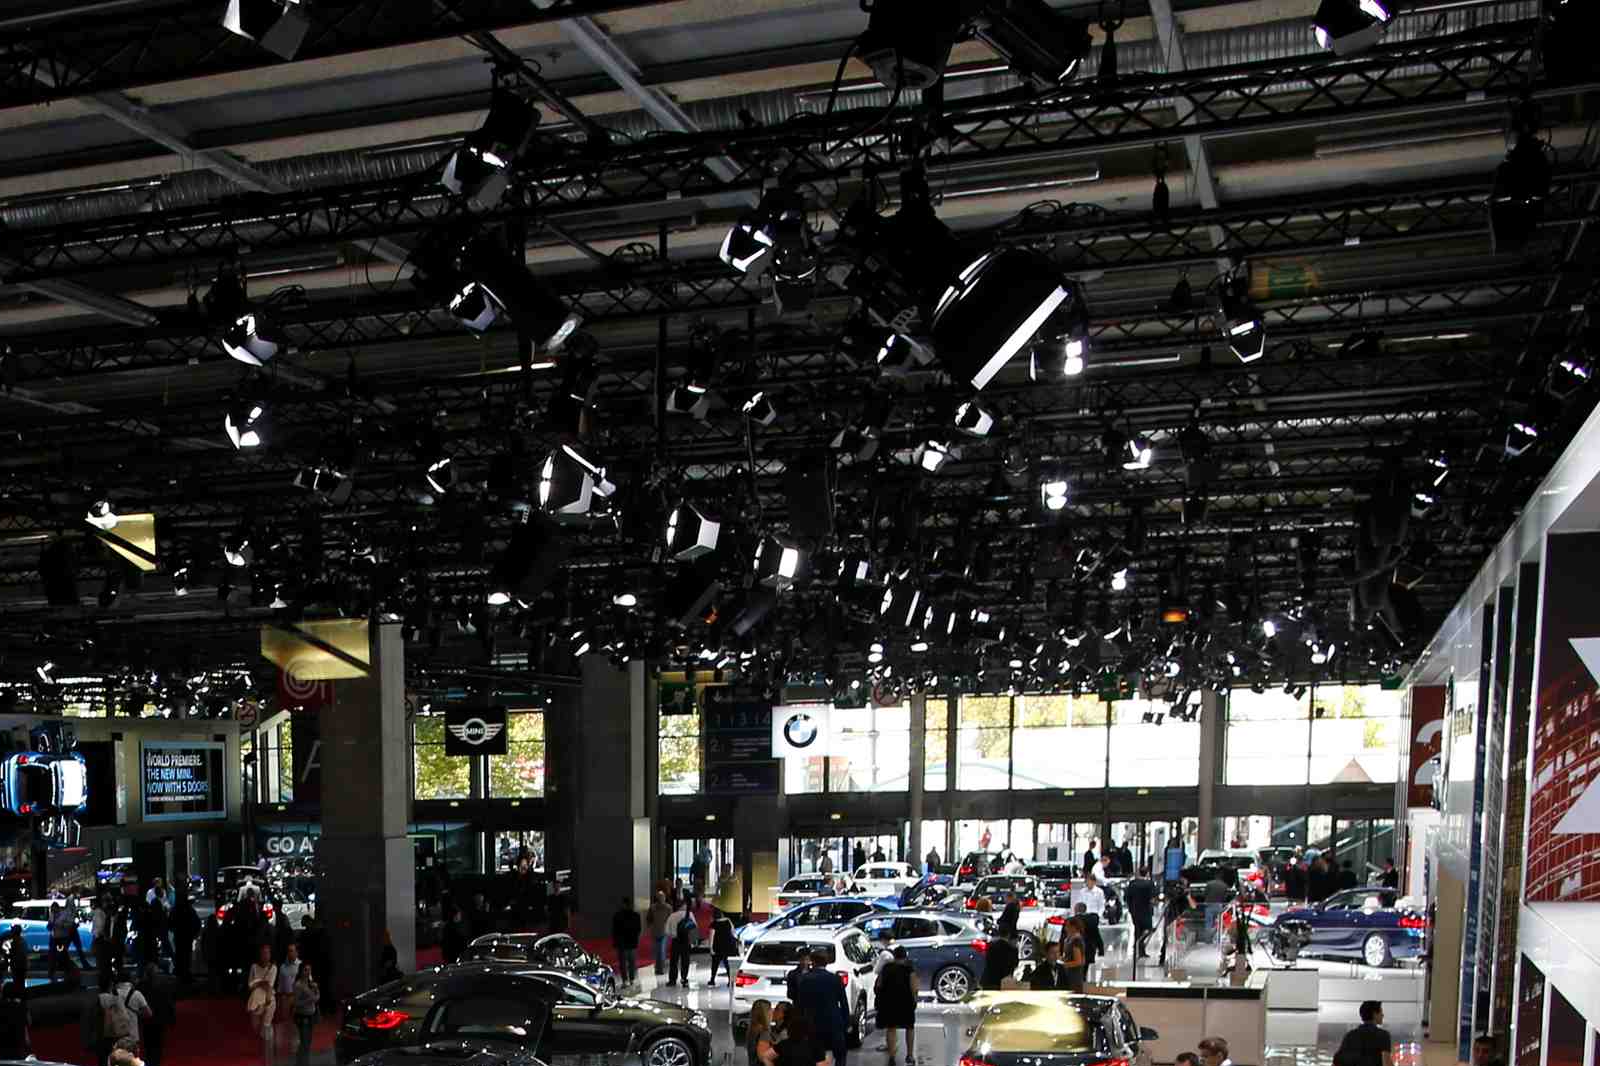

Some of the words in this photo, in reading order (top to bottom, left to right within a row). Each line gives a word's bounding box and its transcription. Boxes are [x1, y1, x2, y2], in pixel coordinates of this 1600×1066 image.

[147, 767, 160, 780] THE
[160, 767, 176, 780] NEW
[164, 781, 182, 793] WITH
[266, 836, 295, 853] GO
